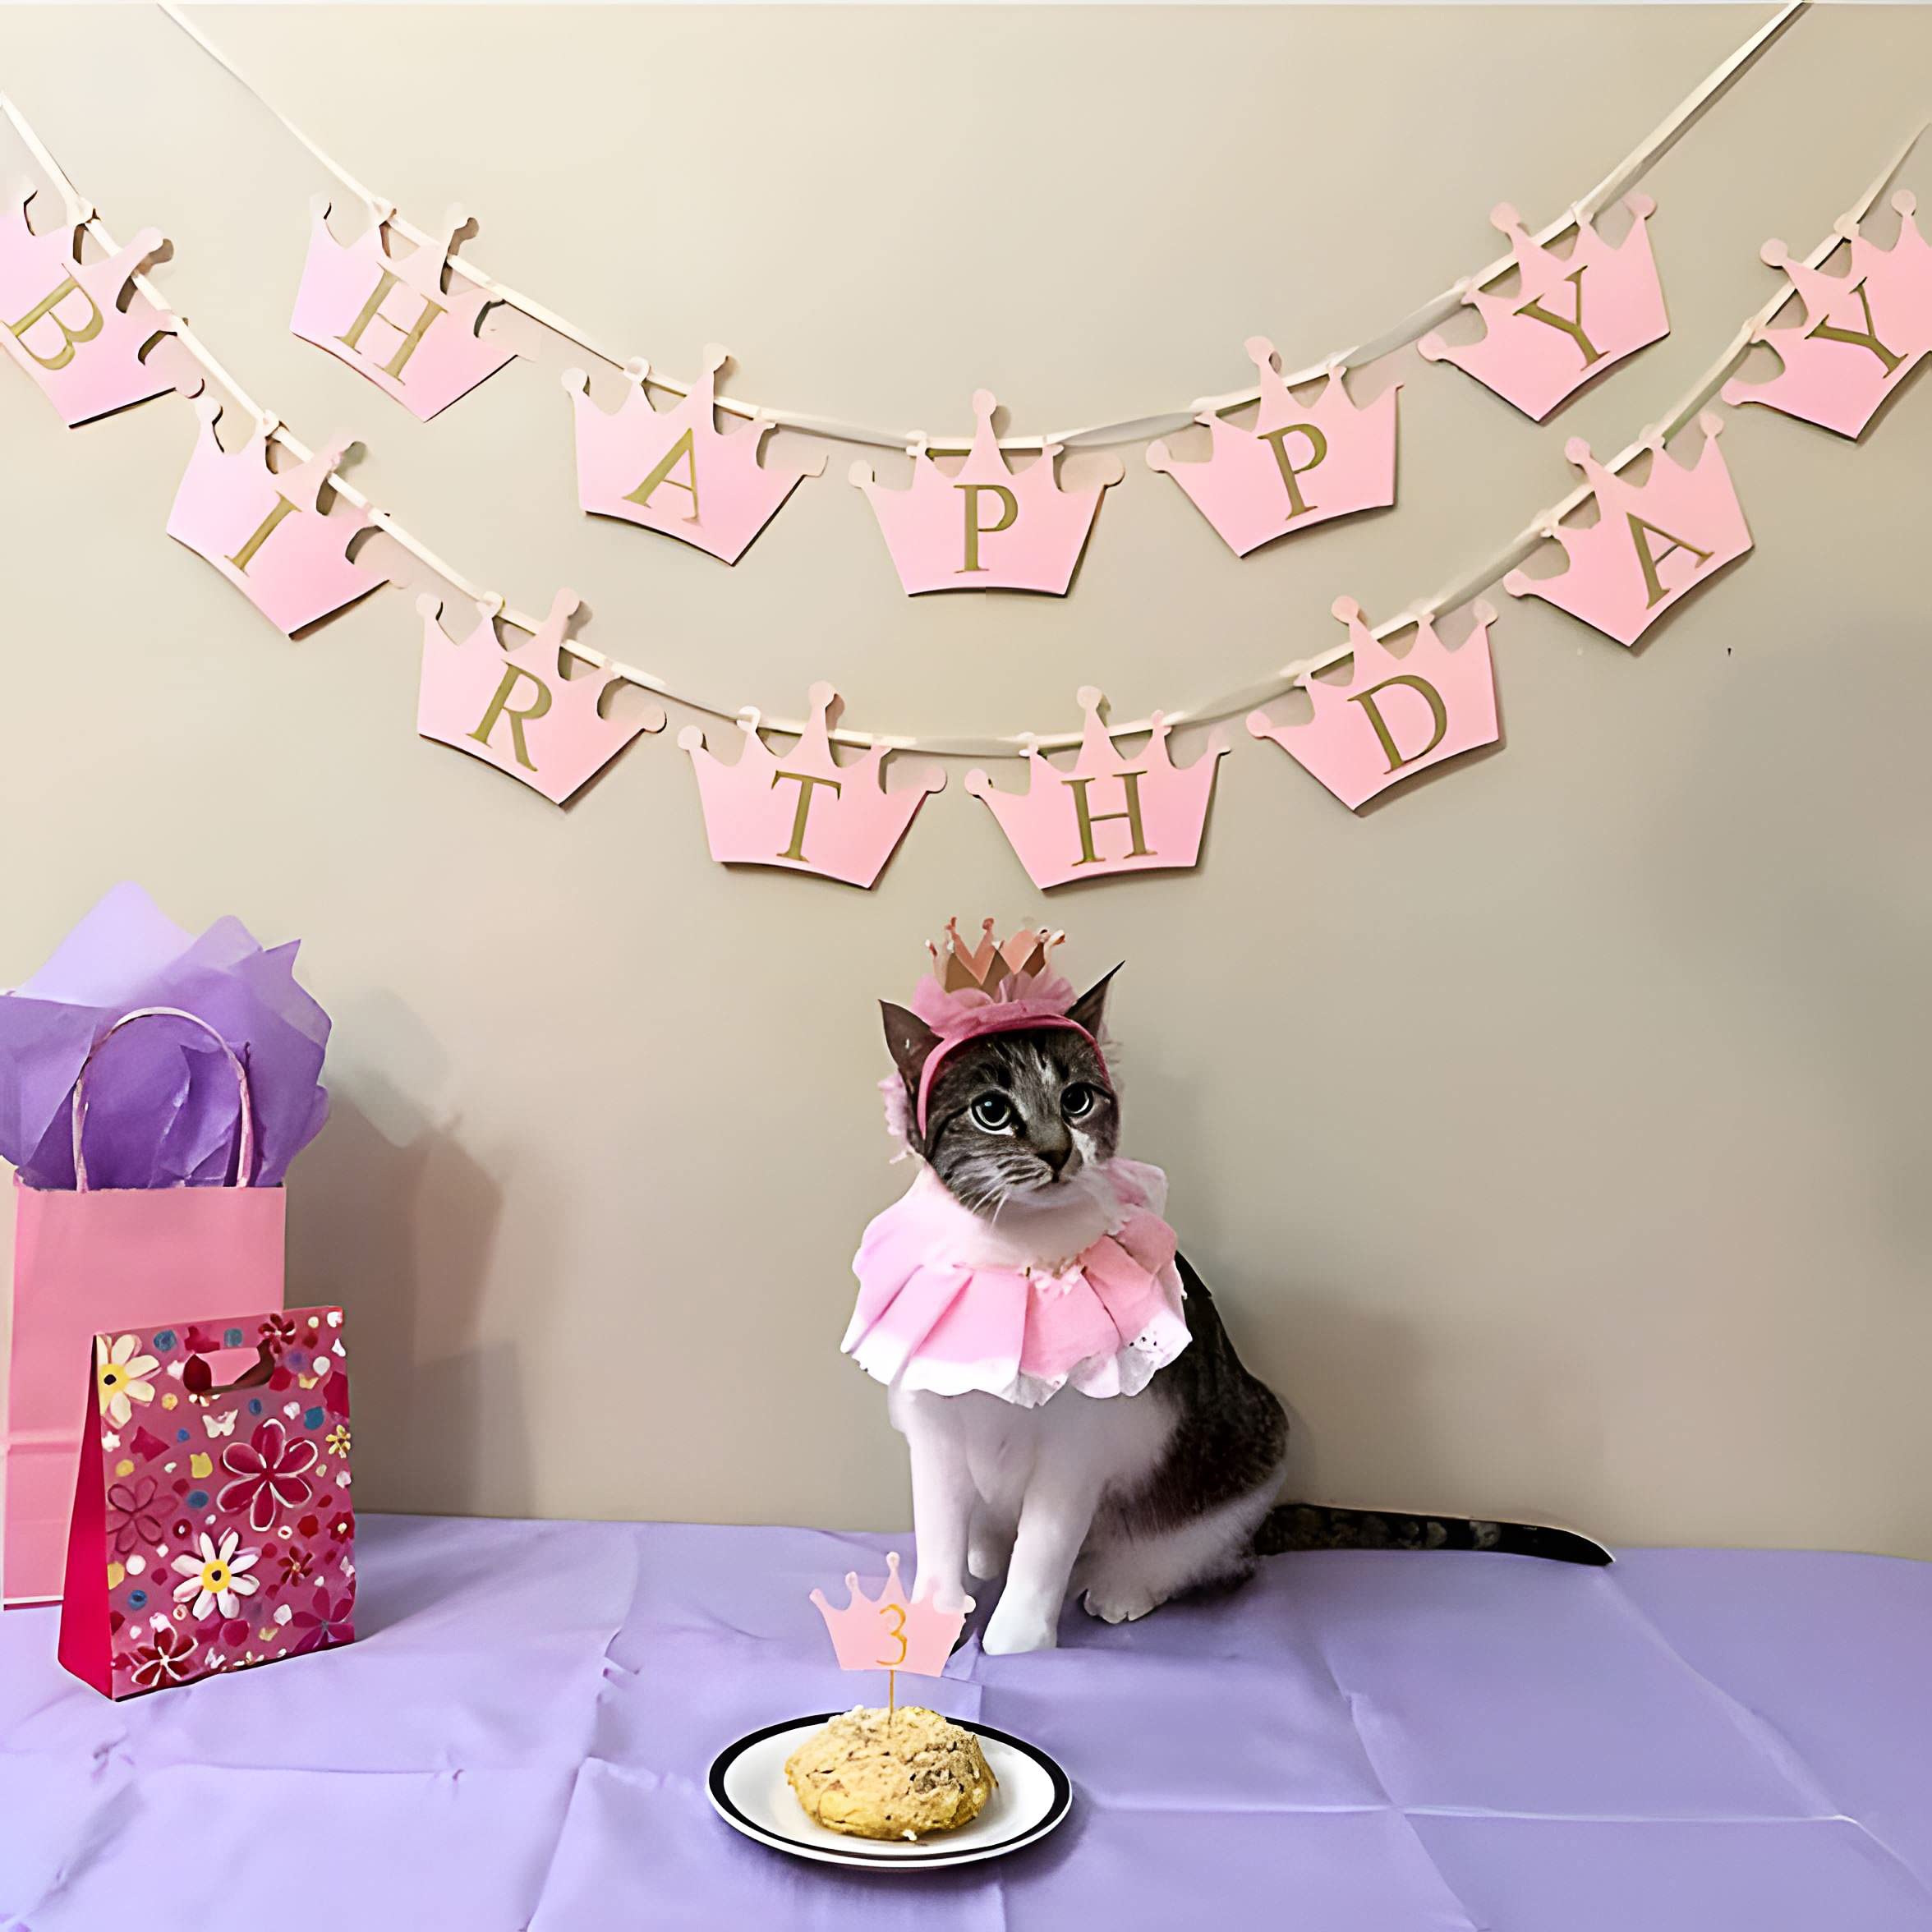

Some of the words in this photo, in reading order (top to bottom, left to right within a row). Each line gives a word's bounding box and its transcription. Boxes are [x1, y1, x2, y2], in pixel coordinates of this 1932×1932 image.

[1, 263, 1908, 865] BIRTHDAY
[333, 261, 1610, 573] HAPPY
[876, 1603, 908, 1666] 3
